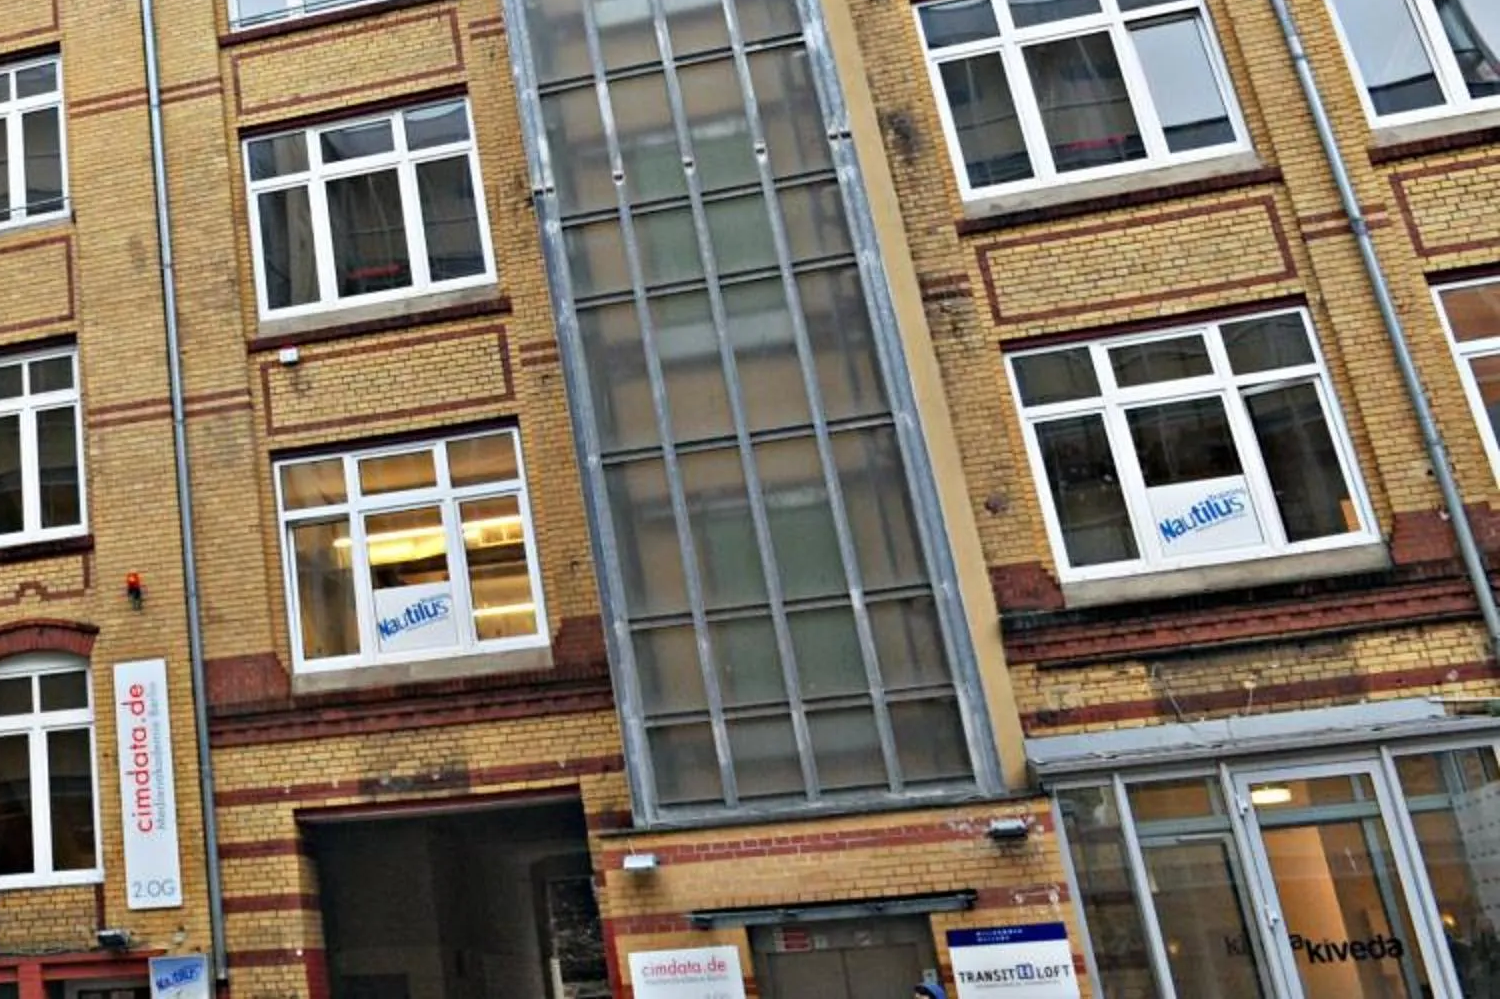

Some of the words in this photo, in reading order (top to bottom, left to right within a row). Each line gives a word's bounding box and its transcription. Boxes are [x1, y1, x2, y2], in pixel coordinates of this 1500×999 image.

[1159, 497, 1245, 543] Nautilus
[377, 601, 449, 641] Nautilus
[120, 683, 153, 833] cimdata.de
[641, 955, 727, 977] cimdata.de
[1304, 934, 1405, 964] kiveda
[958, 967, 1016, 984] TRANSIT
[1035, 964, 1071, 979] LOFT
